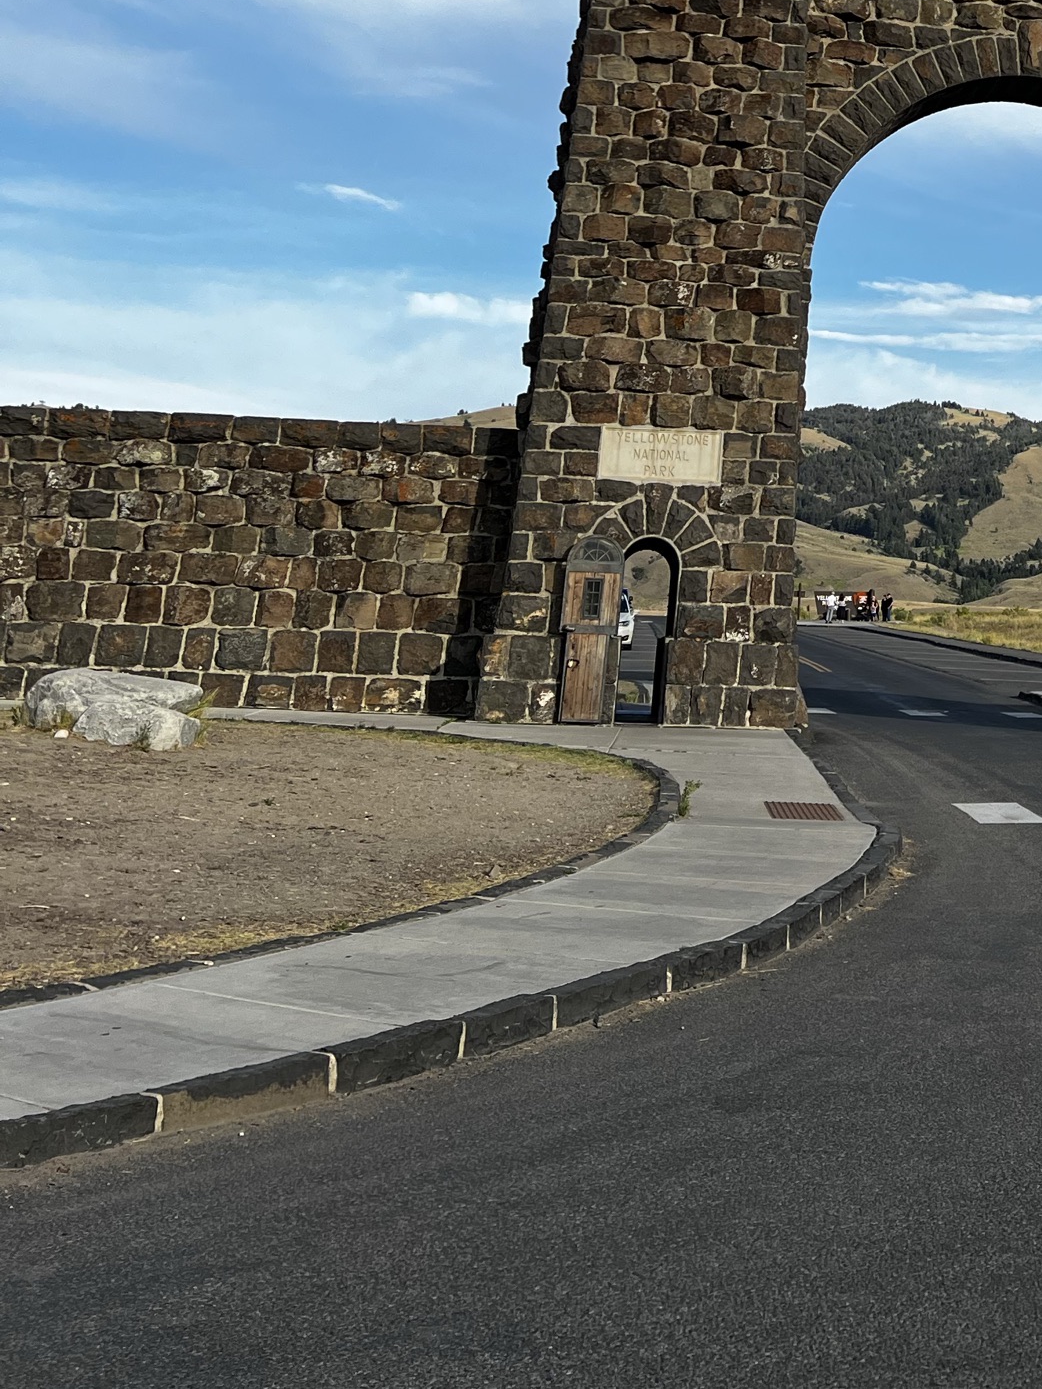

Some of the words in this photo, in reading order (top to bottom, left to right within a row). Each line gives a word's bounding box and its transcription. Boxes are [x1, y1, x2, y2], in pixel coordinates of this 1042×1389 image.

[617, 431, 709, 446] YELLOWSTONE
[633, 448, 690, 462] NATIONAL
[643, 465, 675, 477] PARK
